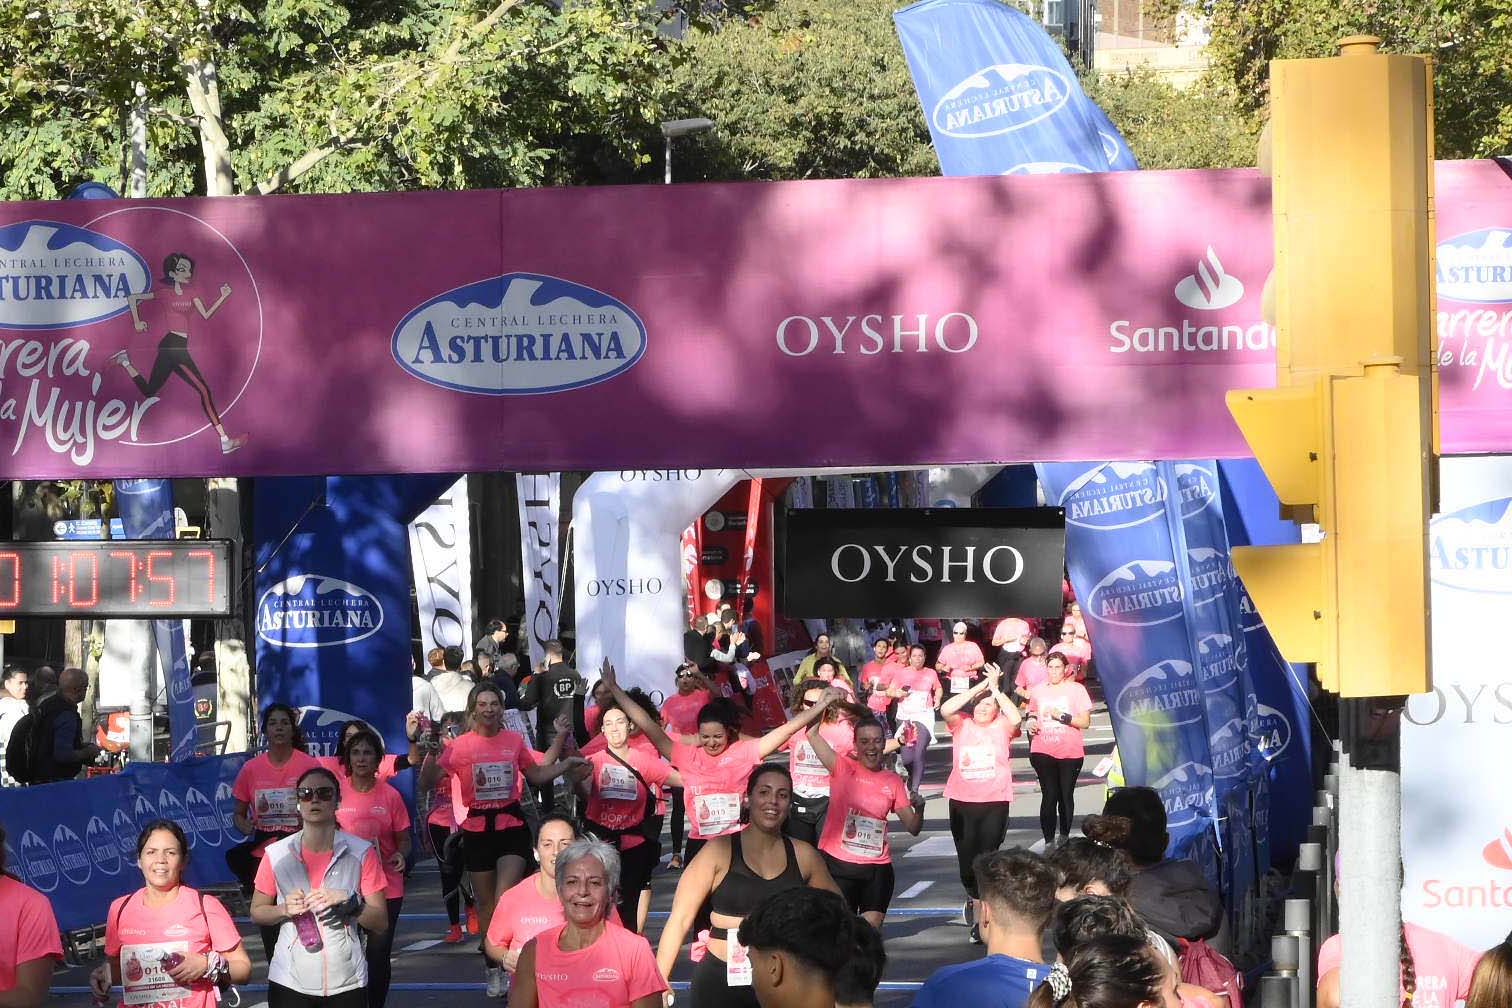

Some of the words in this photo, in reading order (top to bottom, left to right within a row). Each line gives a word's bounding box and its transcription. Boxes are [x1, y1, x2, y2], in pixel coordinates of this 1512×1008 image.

[54, 256, 126, 267] LECHERA
[451, 316, 529, 329] CENTRAL
[538, 313, 618, 326] LECHERA
[776, 312, 979, 356] OYSHO
[412, 320, 626, 365] ASTURIANA
[1109, 320, 1276, 353] Santand
[12, 372, 159, 467] Mujer
[831, 544, 1024, 584] OYSHO
[587, 577, 662, 597] OYSHO
[261, 603, 373, 631] ASTURIANA
[559, 682, 572, 692] BP
